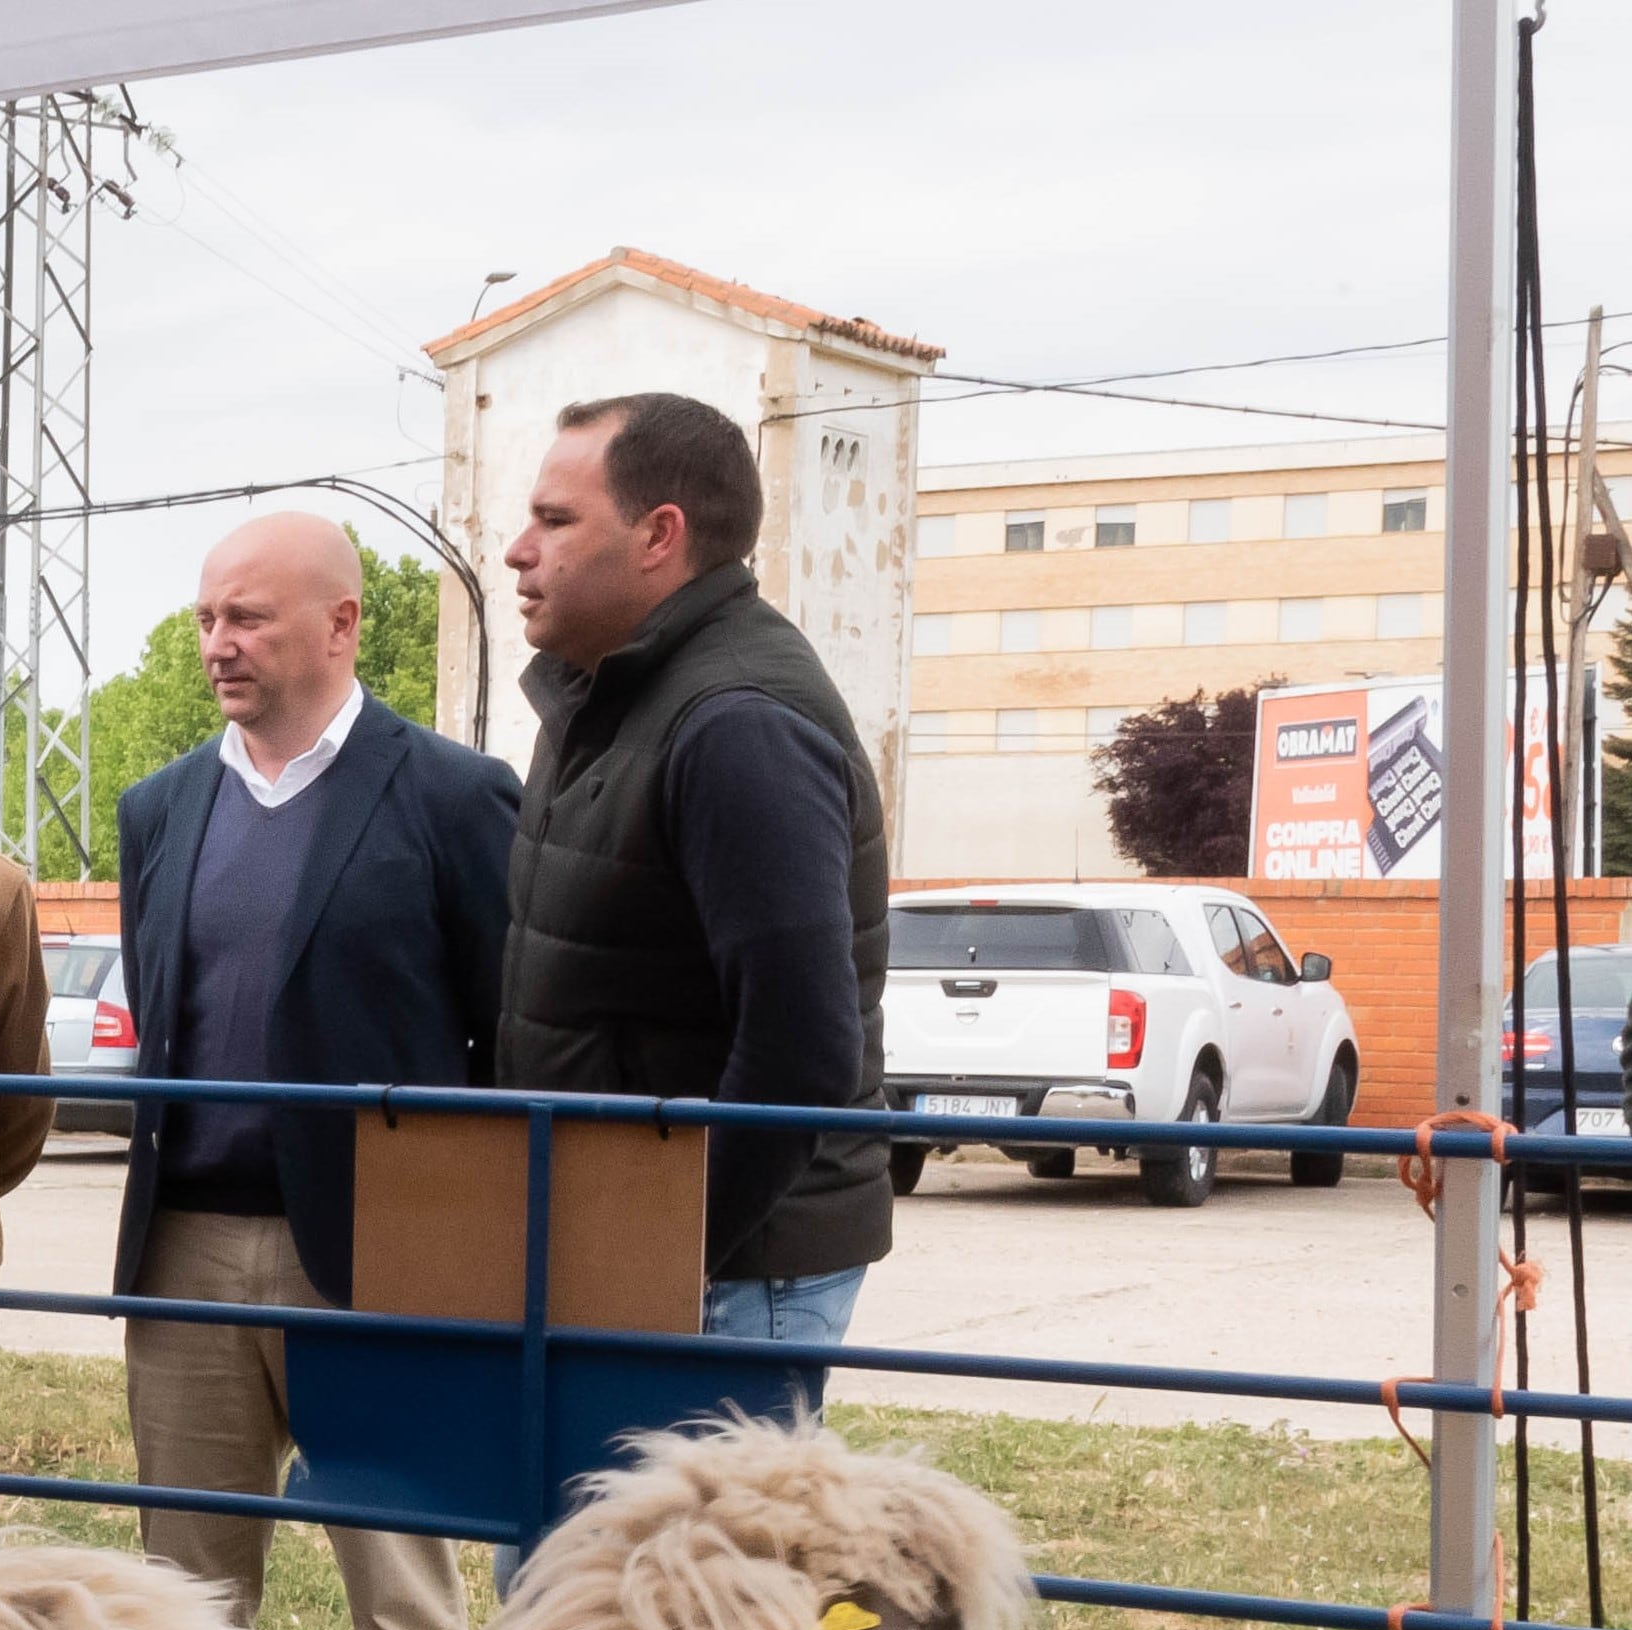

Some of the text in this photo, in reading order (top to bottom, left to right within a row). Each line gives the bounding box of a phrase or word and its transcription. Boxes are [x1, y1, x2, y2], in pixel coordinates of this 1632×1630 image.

[1277, 725, 1356, 757] OBRAMAT
[1266, 818, 1361, 848] COMPRA
[1265, 848, 1361, 880] ONLINE
[928, 1097, 1012, 1115] 5184 JNY
